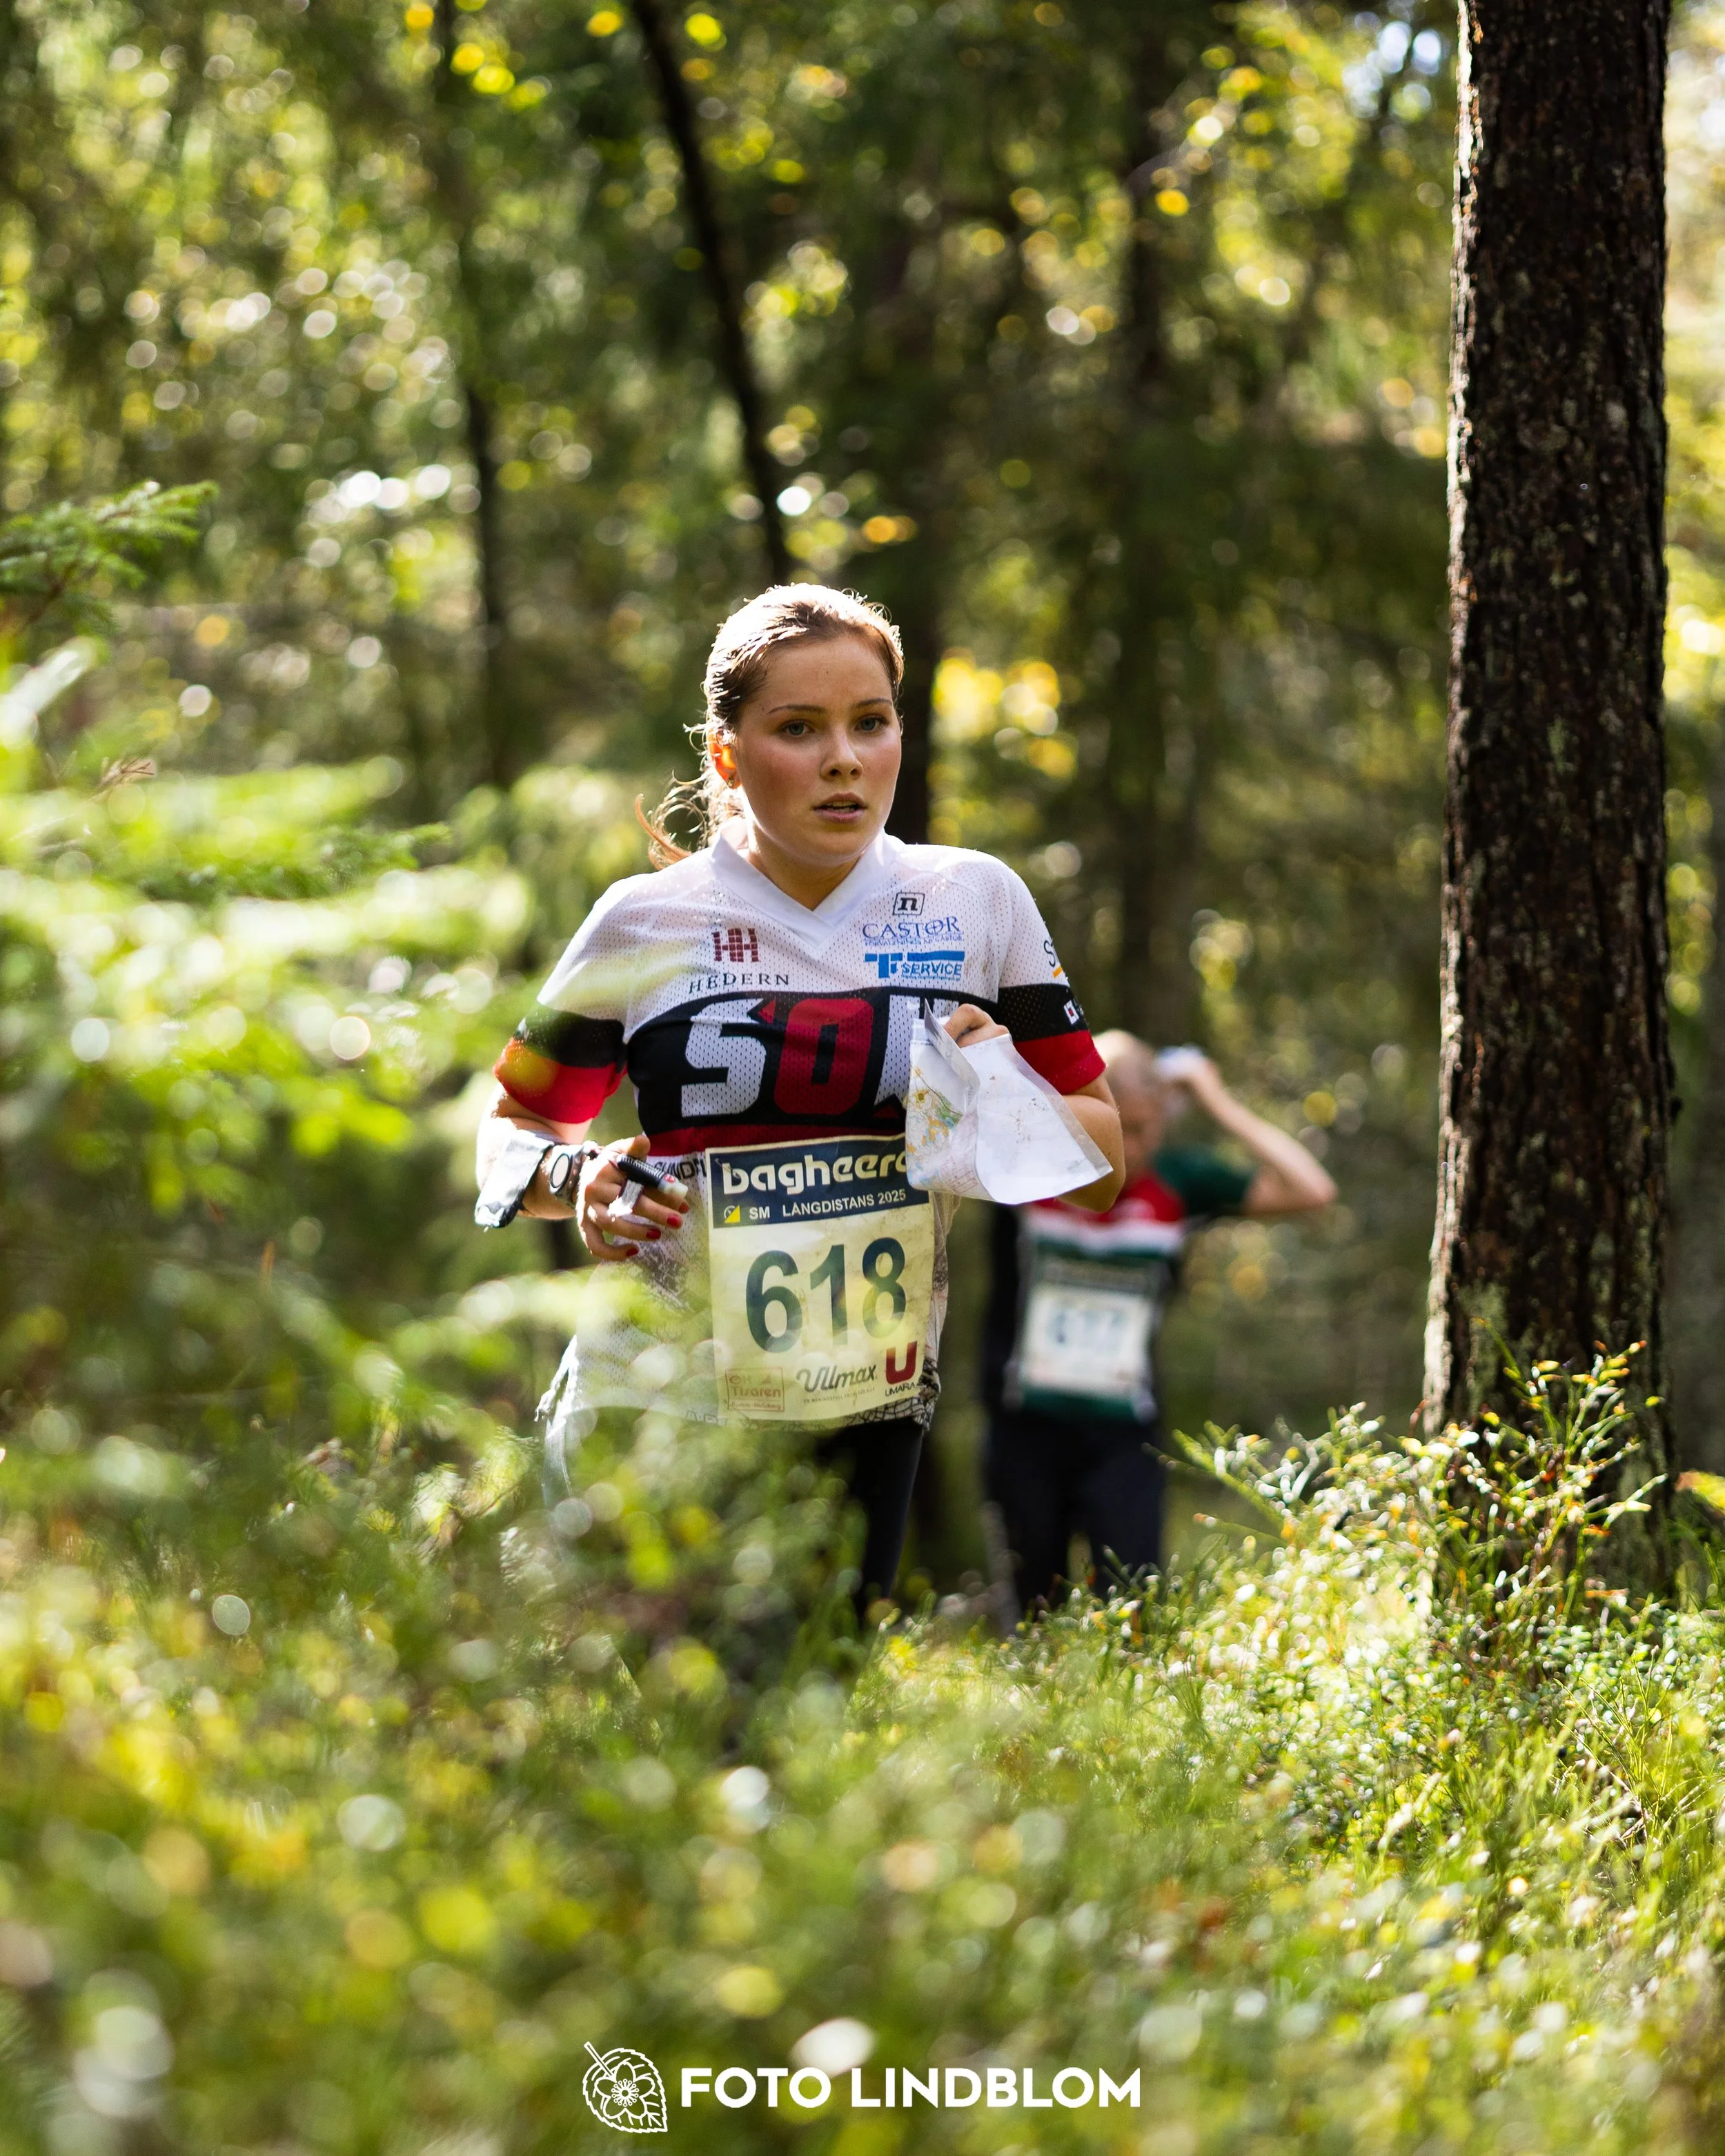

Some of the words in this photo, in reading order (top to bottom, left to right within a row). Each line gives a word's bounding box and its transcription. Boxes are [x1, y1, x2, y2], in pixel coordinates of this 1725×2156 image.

[862, 916, 960, 939] CASTOR
[901, 962, 962, 976] SERVICE
[689, 972, 789, 993] HEDERN
[749, 1207, 770, 1220] SM
[878, 1189, 906, 1205] 2025
[746, 1237, 907, 1354] 618
[796, 1363, 876, 1392] Ullmax
[885, 1382, 916, 1396] UMARA
